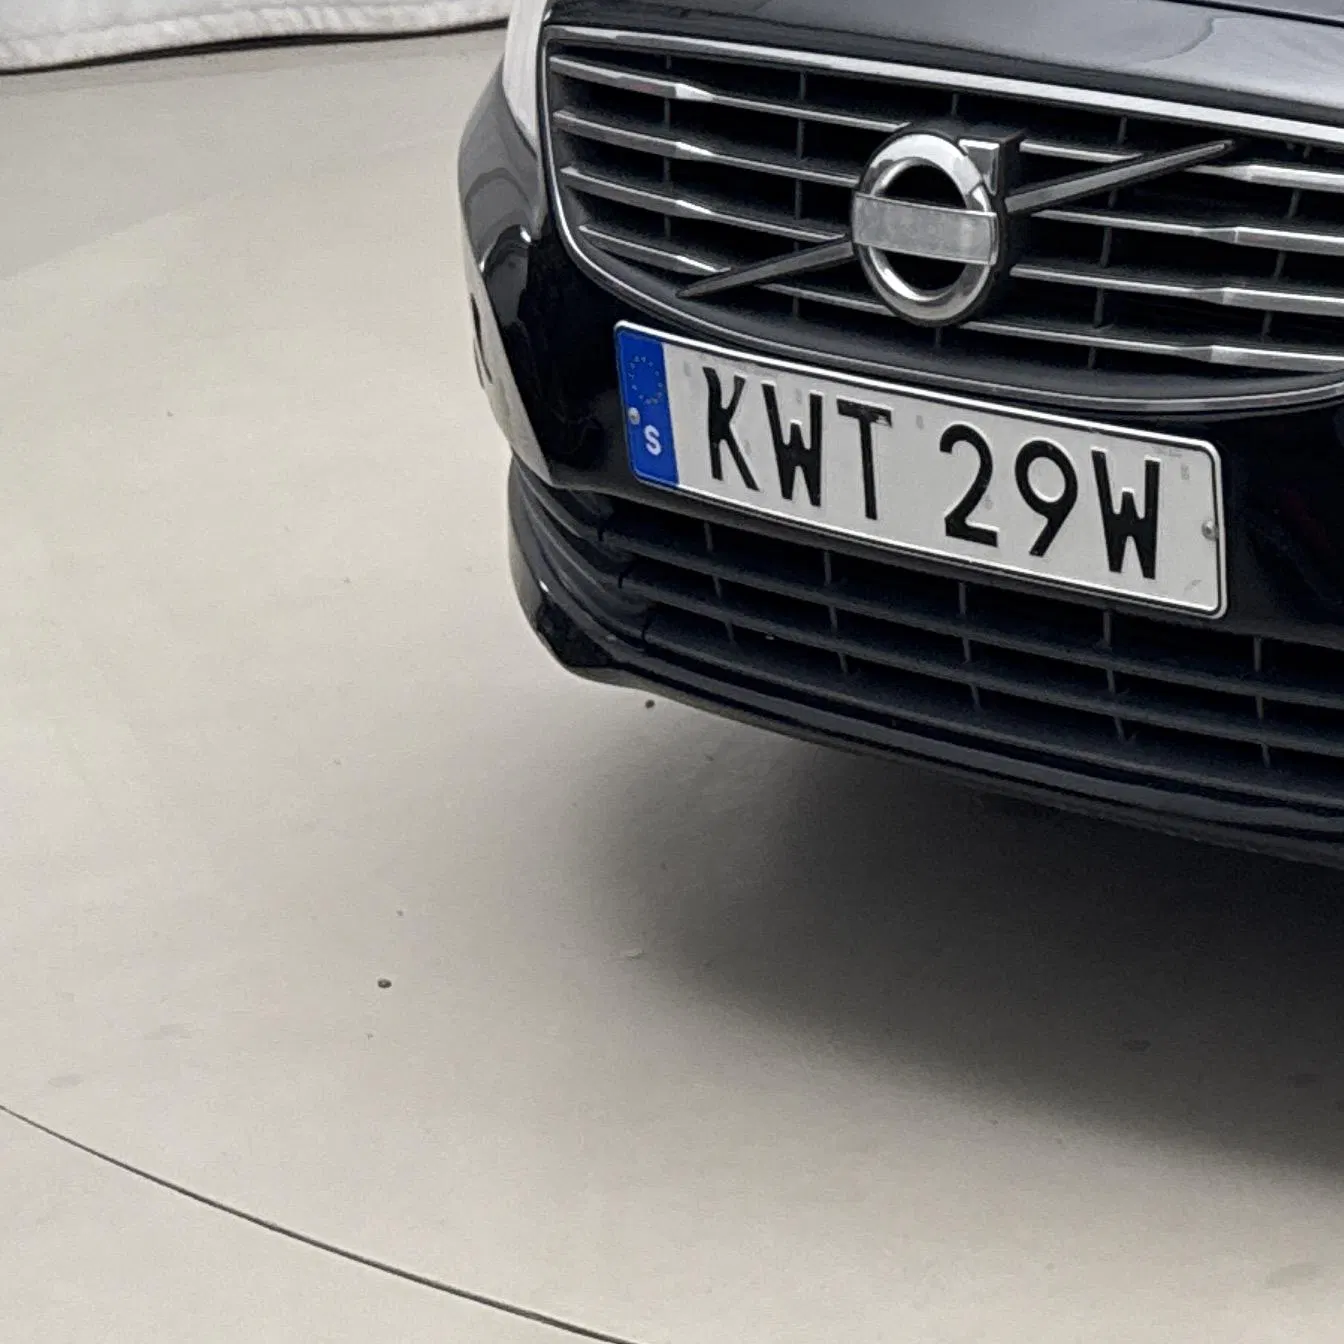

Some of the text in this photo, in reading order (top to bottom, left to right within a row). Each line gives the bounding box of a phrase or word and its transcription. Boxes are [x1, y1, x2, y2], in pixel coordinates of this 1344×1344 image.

[644, 425, 661, 456] S
[703, 367, 1161, 580] KWT 29W
